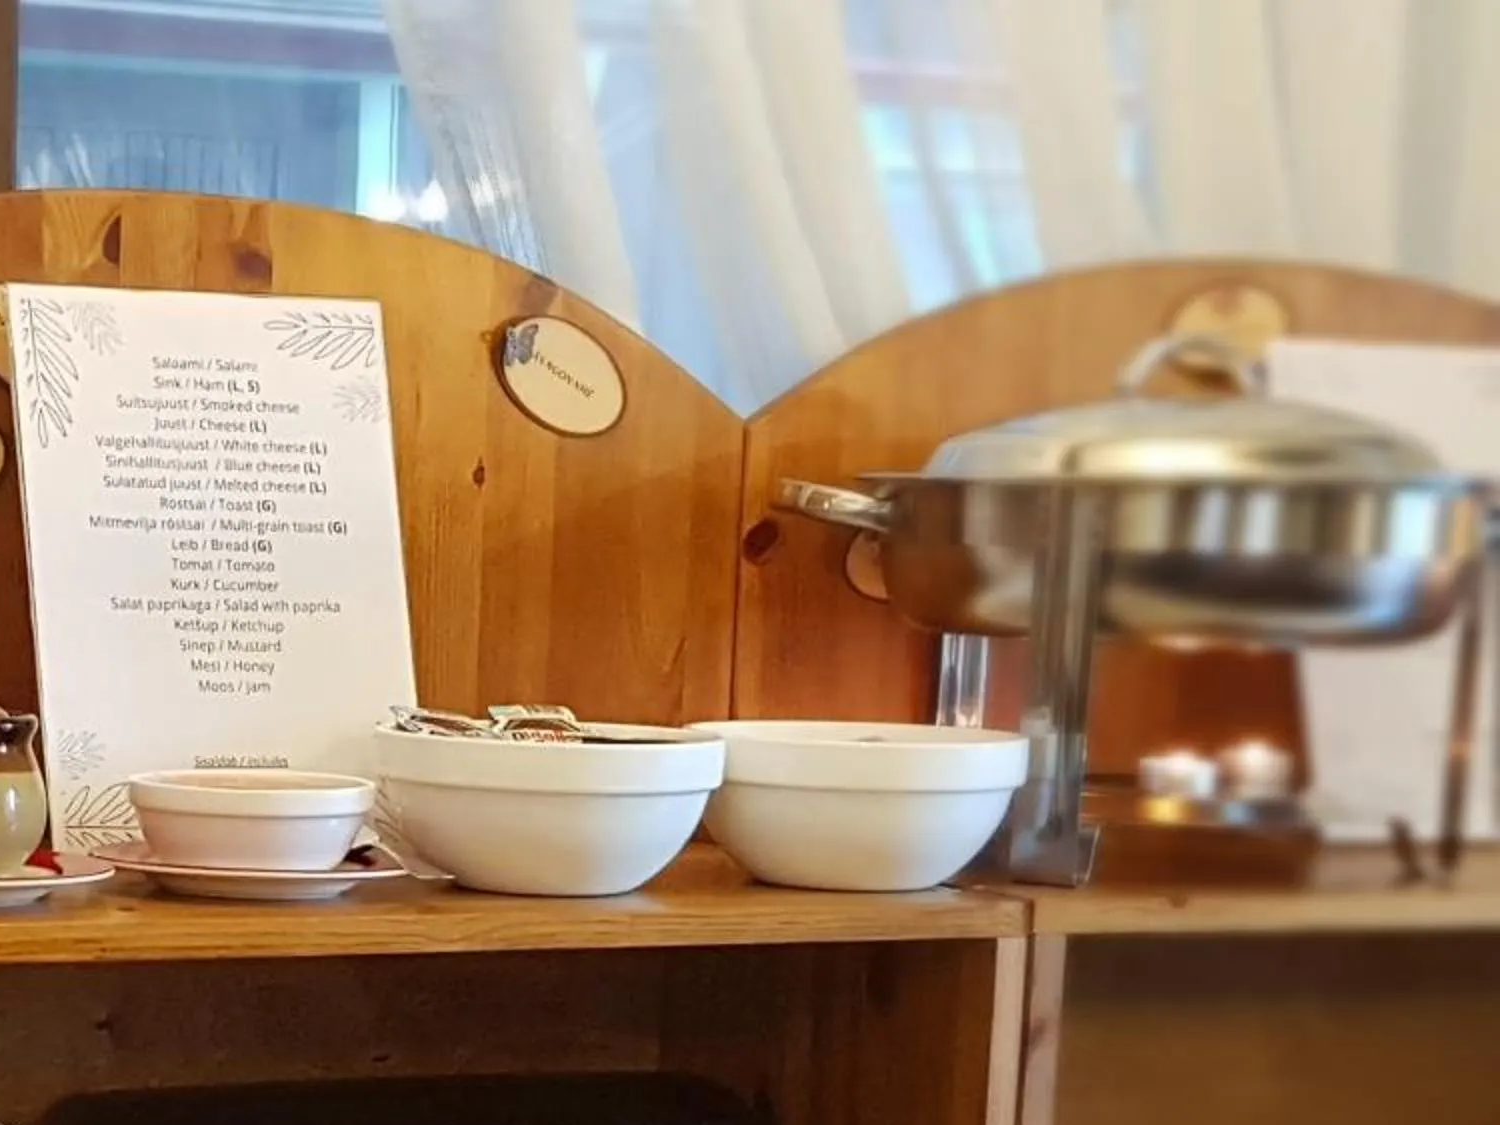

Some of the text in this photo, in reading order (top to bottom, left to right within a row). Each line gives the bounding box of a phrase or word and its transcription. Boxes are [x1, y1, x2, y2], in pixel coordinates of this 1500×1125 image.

[153, 376, 180, 389] Sink
[193, 379, 224, 391] Ham
[200, 399, 252, 412] Smoked
[256, 400, 299, 413] cheese
[154, 417, 186, 431] Juust
[199, 418, 245, 431] Cheese
[250, 419, 267, 433] (L)
[222, 439, 259, 451] White
[262, 441, 306, 453] cheese
[310, 442, 327, 456] (L)
[224, 459, 253, 471] Blue
[256, 461, 300, 473] cheese
[303, 462, 321, 475] (L)
[103, 475, 166, 489] Sulatatud
[169, 478, 202, 492] juust
[214, 479, 258, 492] Melted
[262, 481, 306, 493] cheese
[309, 482, 327, 495] (L)
[218, 498, 253, 511] Toast
[257, 499, 276, 513] (G)
[292, 521, 324, 533] toast
[328, 521, 347, 535] (G)
[171, 539, 198, 551] Leib
[211, 539, 249, 552] Bread
[252, 540, 272, 554] (G)
[172, 557, 213, 571] Tomat
[227, 559, 275, 572] Tomato
[171, 578, 200, 591] Kurk
[213, 579, 279, 592] Cucumber
[110, 597, 143, 610] Salat
[148, 599, 211, 614] paprikaga
[223, 599, 258, 612] Salad
[261, 600, 289, 612] with
[293, 600, 341, 614] paprika
[231, 619, 284, 634] Ketchup
[179, 639, 216, 653] Sinep
[228, 640, 281, 652] Mustard
[190, 659, 221, 672] Mesi
[233, 660, 275, 675] Honey
[198, 680, 235, 692] Moos
